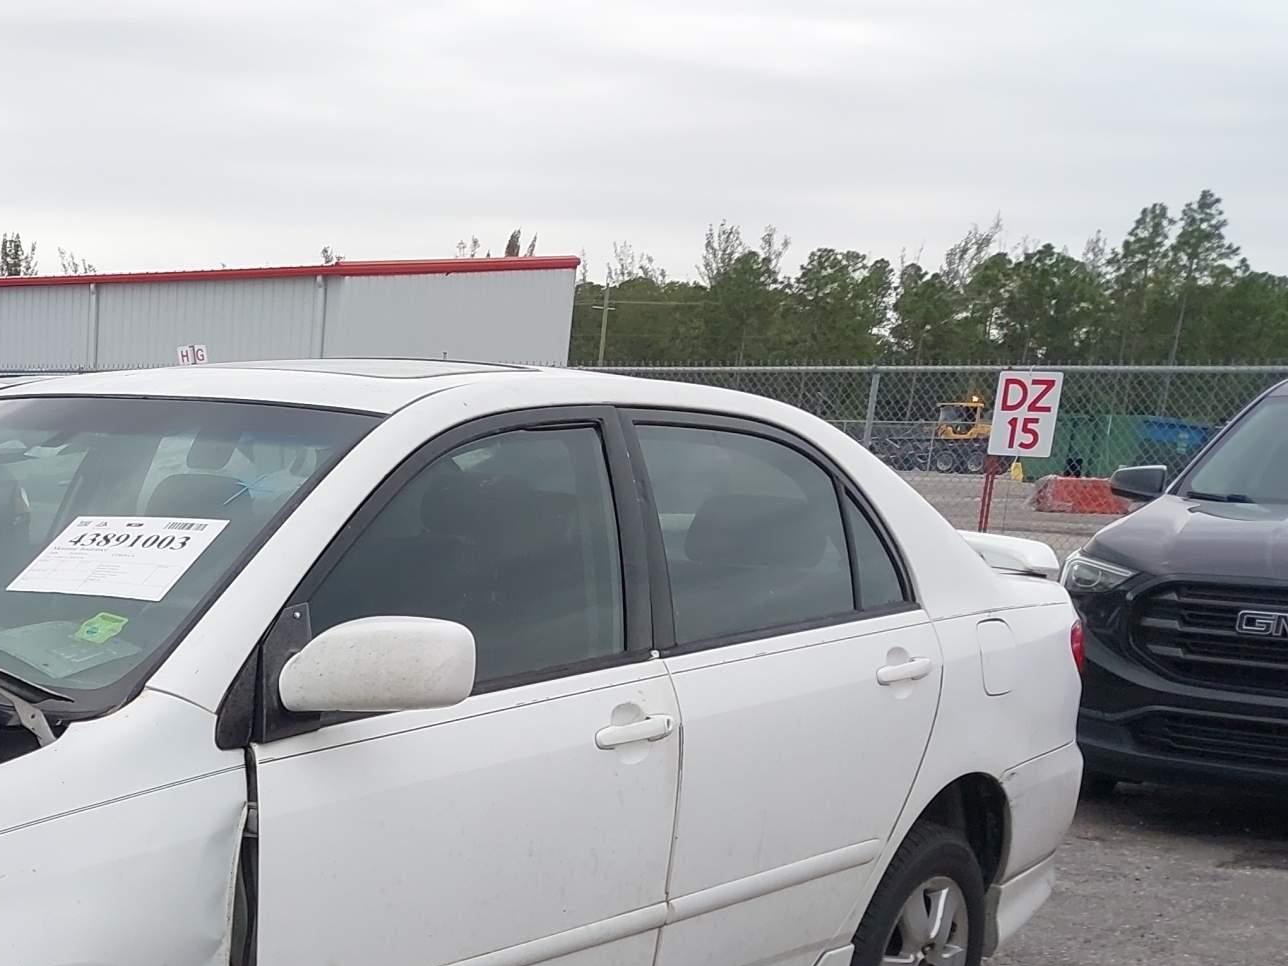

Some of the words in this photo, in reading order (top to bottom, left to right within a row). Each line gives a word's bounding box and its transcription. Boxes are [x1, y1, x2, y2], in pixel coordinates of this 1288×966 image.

[1001, 378, 1056, 412] DZ
[1007, 417, 1040, 449] 15
[68, 532, 191, 551] 43891003
